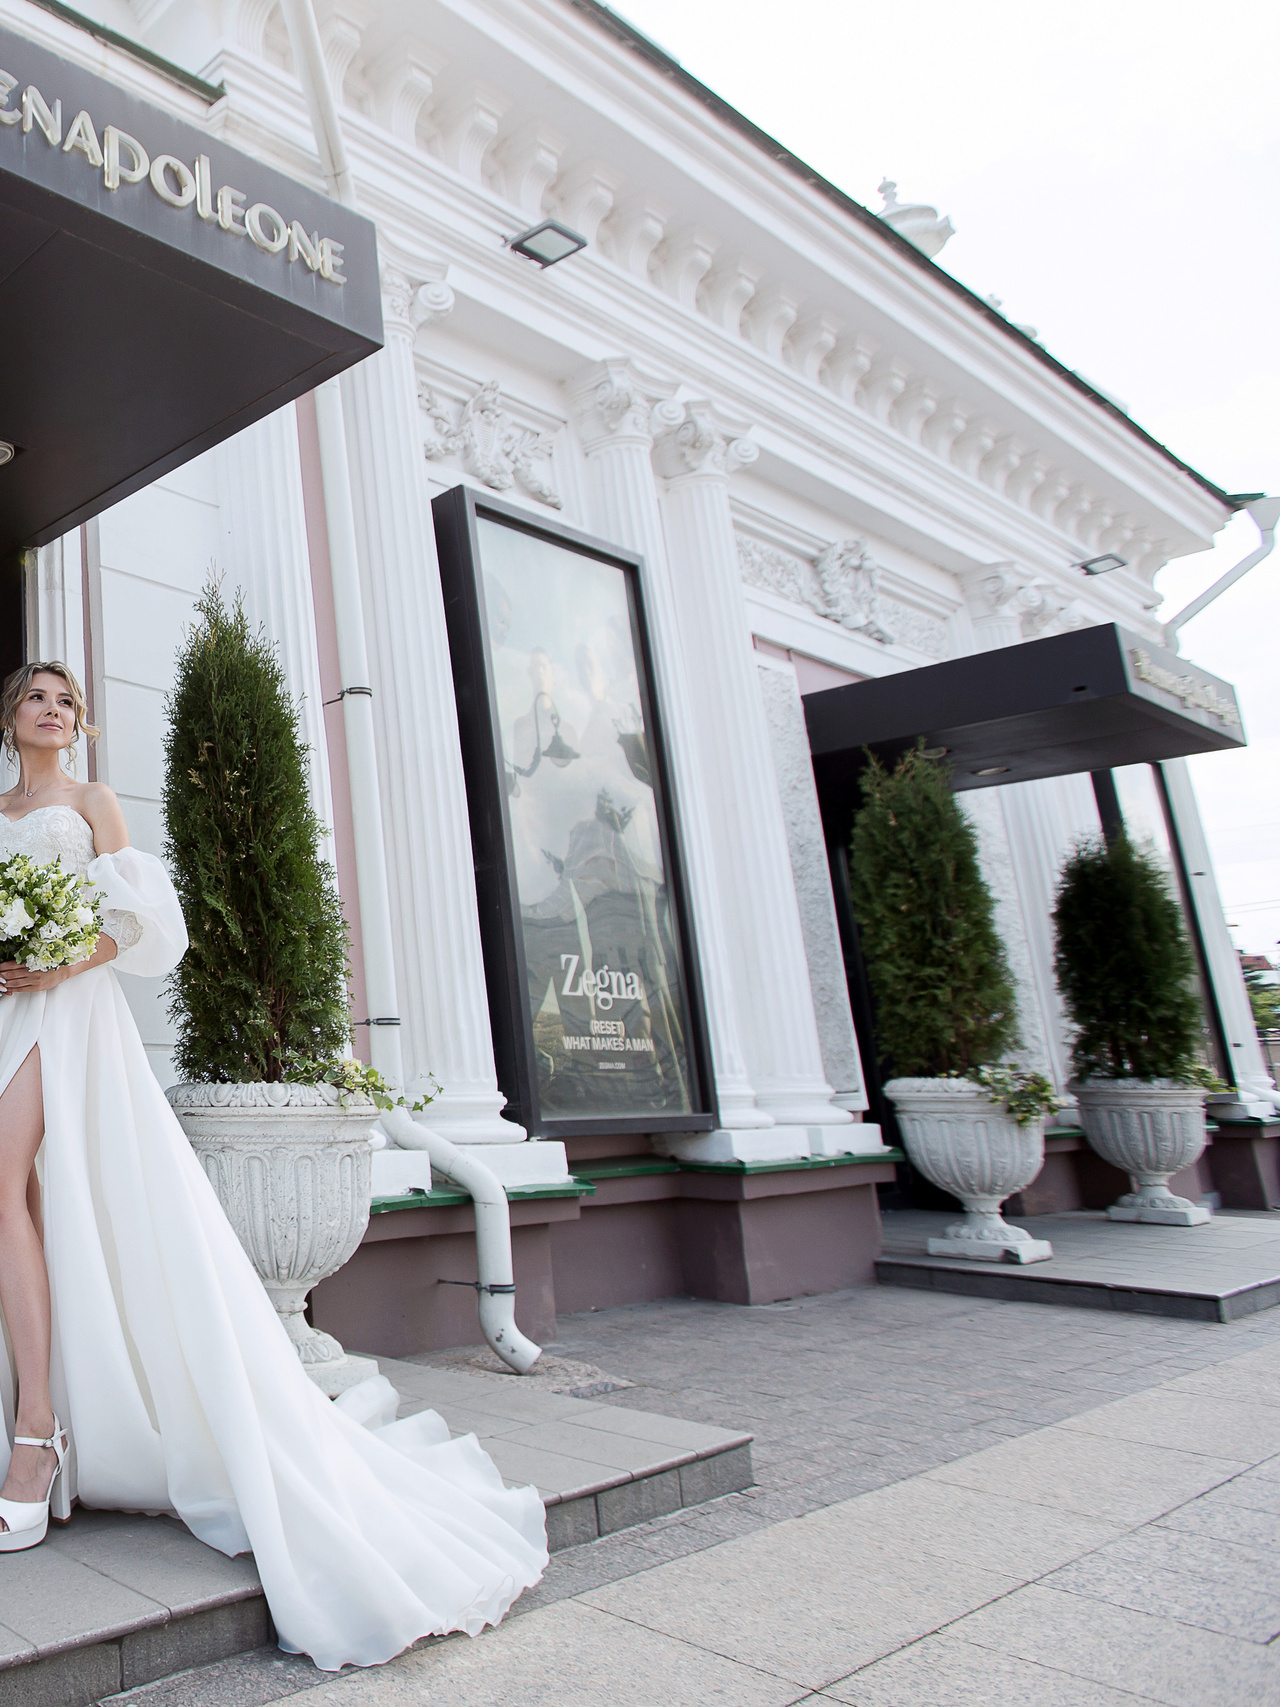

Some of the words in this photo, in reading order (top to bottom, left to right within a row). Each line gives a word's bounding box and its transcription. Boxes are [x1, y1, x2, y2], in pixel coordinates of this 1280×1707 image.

[560, 954, 643, 1010] Zegna
[590, 1020, 625, 1036] (RESET)
[562, 1036, 591, 1050] WHAT
[591, 1037, 624, 1051] MAKES
[625, 1038, 633, 1051] A
[632, 1038, 654, 1052] MAN
